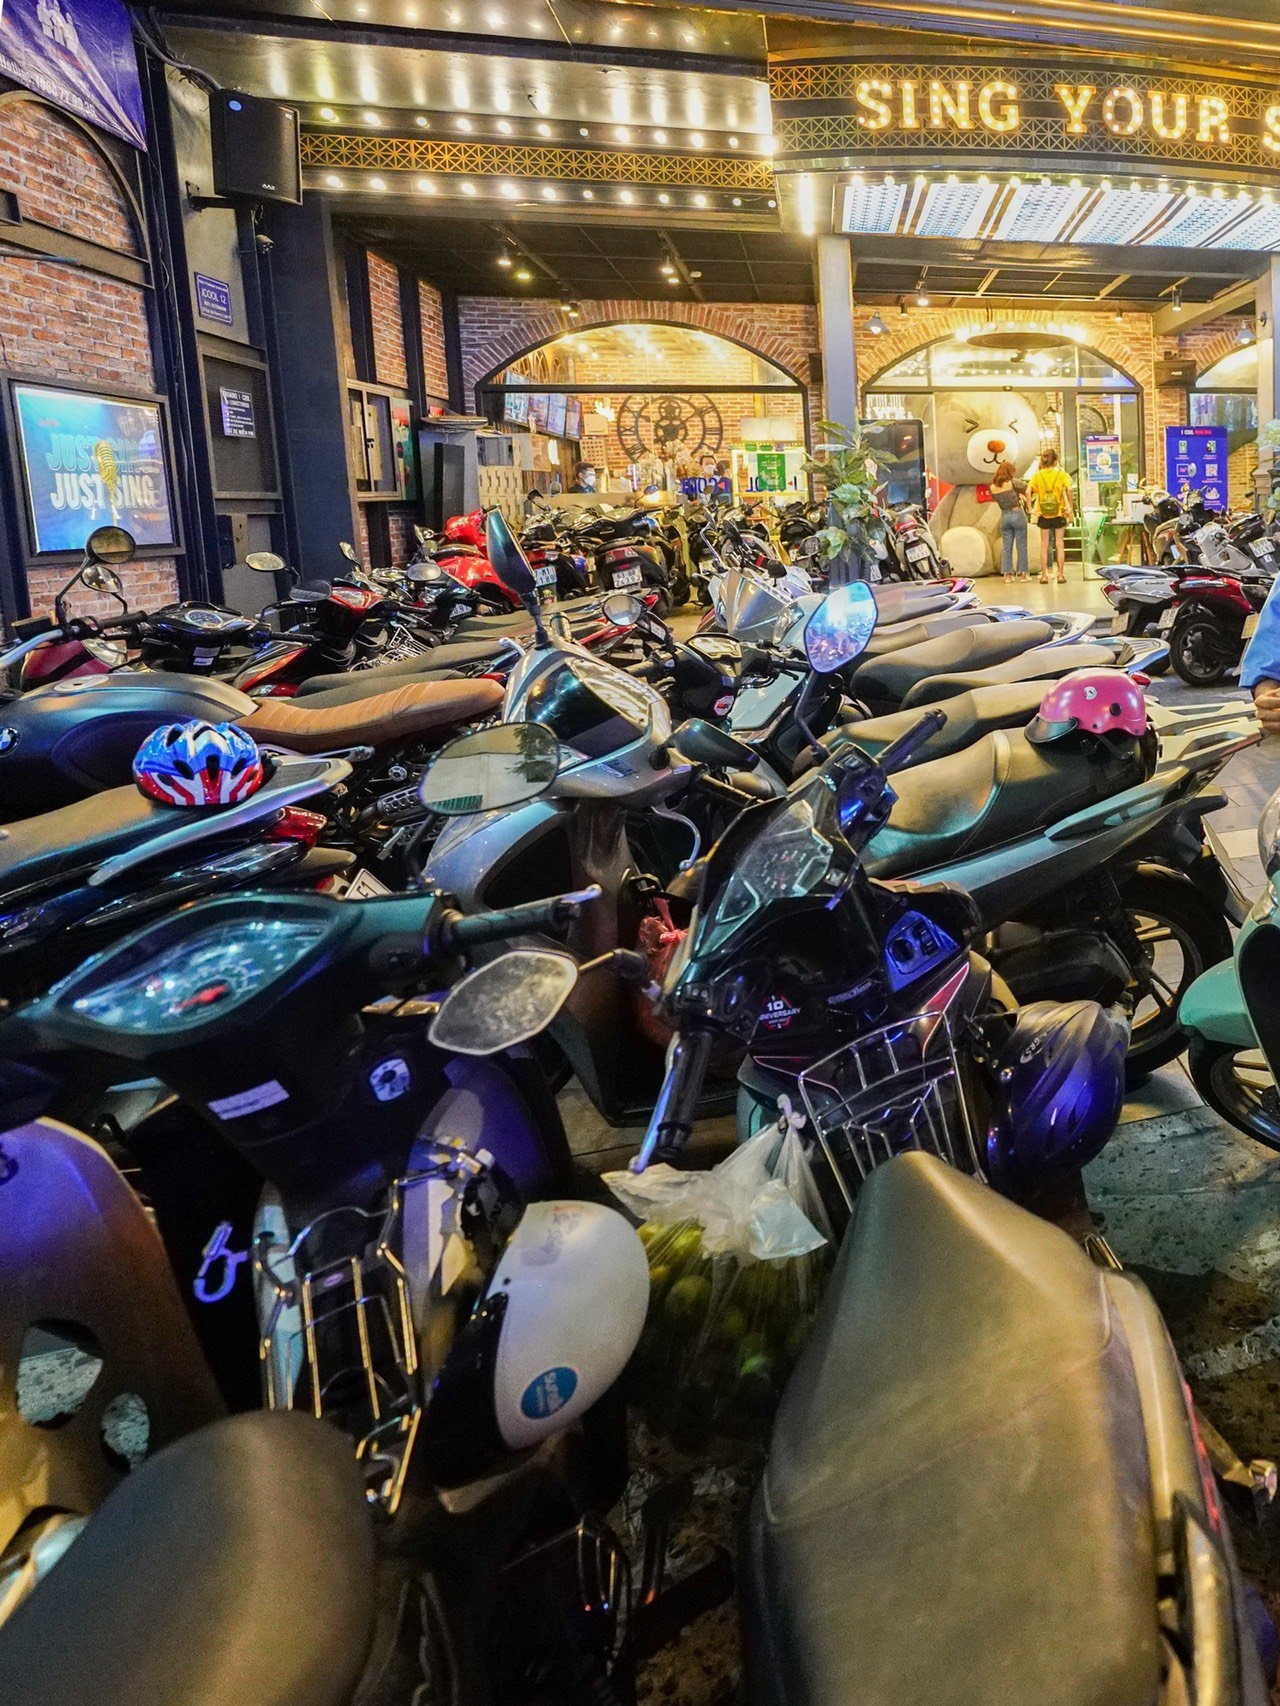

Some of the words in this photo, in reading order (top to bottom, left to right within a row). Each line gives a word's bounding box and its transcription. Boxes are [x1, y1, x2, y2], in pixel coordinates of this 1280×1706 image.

[856, 80, 1019, 131] SING
[1054, 83, 1232, 143] YOUR
[51, 473, 106, 511] JUST
